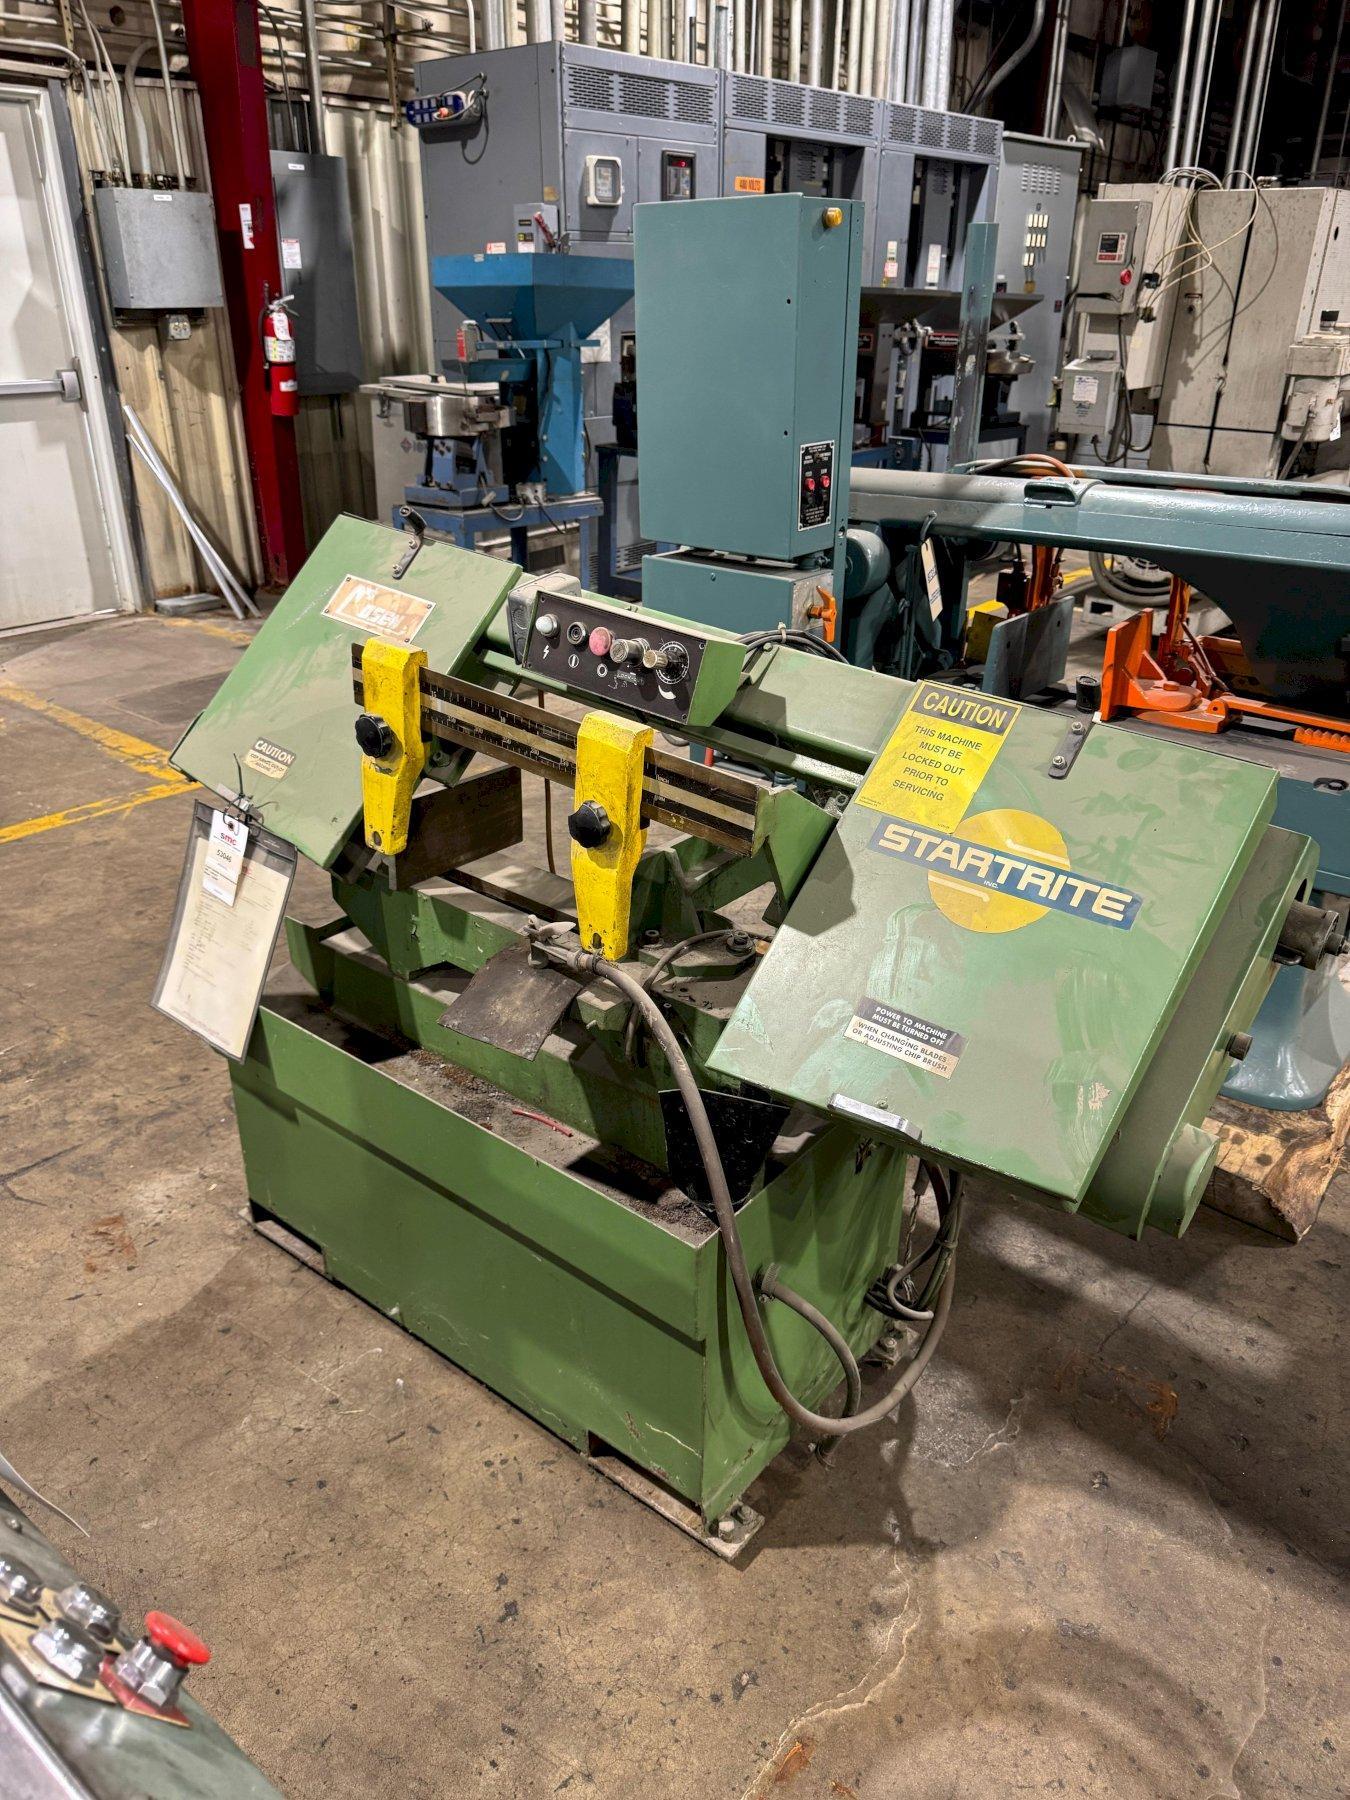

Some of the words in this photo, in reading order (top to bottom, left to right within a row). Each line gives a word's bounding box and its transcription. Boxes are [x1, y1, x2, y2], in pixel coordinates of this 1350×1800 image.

[923, 692, 1007, 728] CAUTION
[915, 725, 935, 737] THIS
[937, 732, 982, 750] MACHINE
[919, 741, 946, 755] MUST
[948, 749, 962, 760] BE
[255, 740, 295, 764] CAUTION
[902, 752, 942, 769] LOCKED
[943, 765, 965, 776] OUT
[892, 779, 944, 801] SERVICING
[903, 767, 933, 782] PRIOR
[935, 776, 949, 787] TO
[878, 823, 1133, 922] STARTRITE
[872, 1014, 891, 1025] MUST
[892, 1021, 900, 1029] BE
[901, 1024, 929, 1040] TURNED
[930, 1036, 945, 1046] OFF
[875, 1006, 901, 1021] POWER
[902, 1017, 913, 1025] TO
[914, 1021, 948, 1040] MACHINE
[852, 1028, 863, 1036] OR
[863, 1033, 903, 1053] ADJUSTING
[904, 1049, 921, 1060] CHIP
[922, 1057, 948, 1072] BRUSH
[858, 1021, 879, 1035] WHEN
[880, 1031, 919, 1051] CHANGING
[920, 1047, 947, 1063] BLADES
